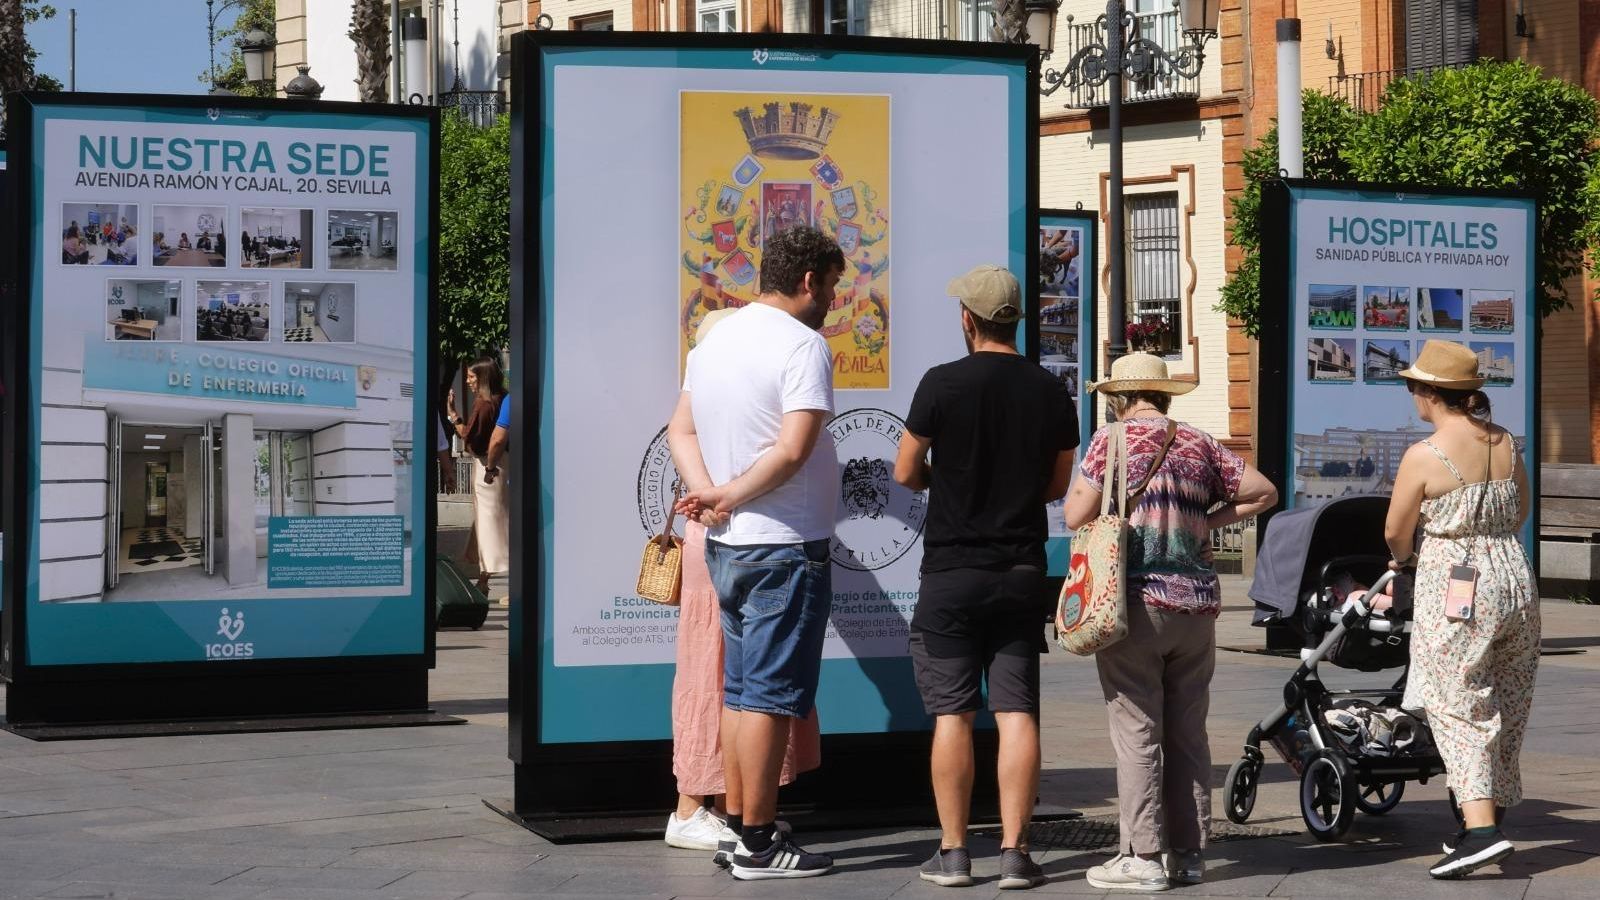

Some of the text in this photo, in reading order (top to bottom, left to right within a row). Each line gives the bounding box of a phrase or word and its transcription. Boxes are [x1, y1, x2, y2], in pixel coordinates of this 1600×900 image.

[79, 134, 390, 177] NUESTRA SEDE
[75, 171, 392, 195] AVENIDA RAMÓN Y CAJAL, 20. SEVILLA
[1329, 216, 1498, 250] HOSPITALES
[1316, 247, 1510, 267] SANIDAD PÚBLICA Y PRIVADA HOY
[199, 352, 280, 375] COLEGIO
[288, 364, 349, 382] OFICIAL
[168, 371, 307, 397] DE ENFERMERÍA
[833, 418, 903, 442] CIAL DE PR
[648, 470, 662, 525] COLEGIO
[834, 538, 902, 562] EVILLA
[862, 590, 877, 600] de
[880, 590, 919, 600] Matron
[600, 607, 680, 620] la Provincia d
[832, 603, 906, 614] Practicantes
[572, 625, 605, 634] Ambos
[607, 624, 646, 636] colegios
[838, 618, 872, 630] Colegio
[873, 618, 885, 626] de
[886, 617, 908, 626] Enfe
[840, 629, 875, 640] Colegio
[876, 628, 887, 638] de
[890, 627, 910, 637] Enfe
[206, 642, 254, 658] ICOES
[582, 638, 590, 646] al
[592, 636, 628, 647] Colegio
[630, 636, 643, 644] de
